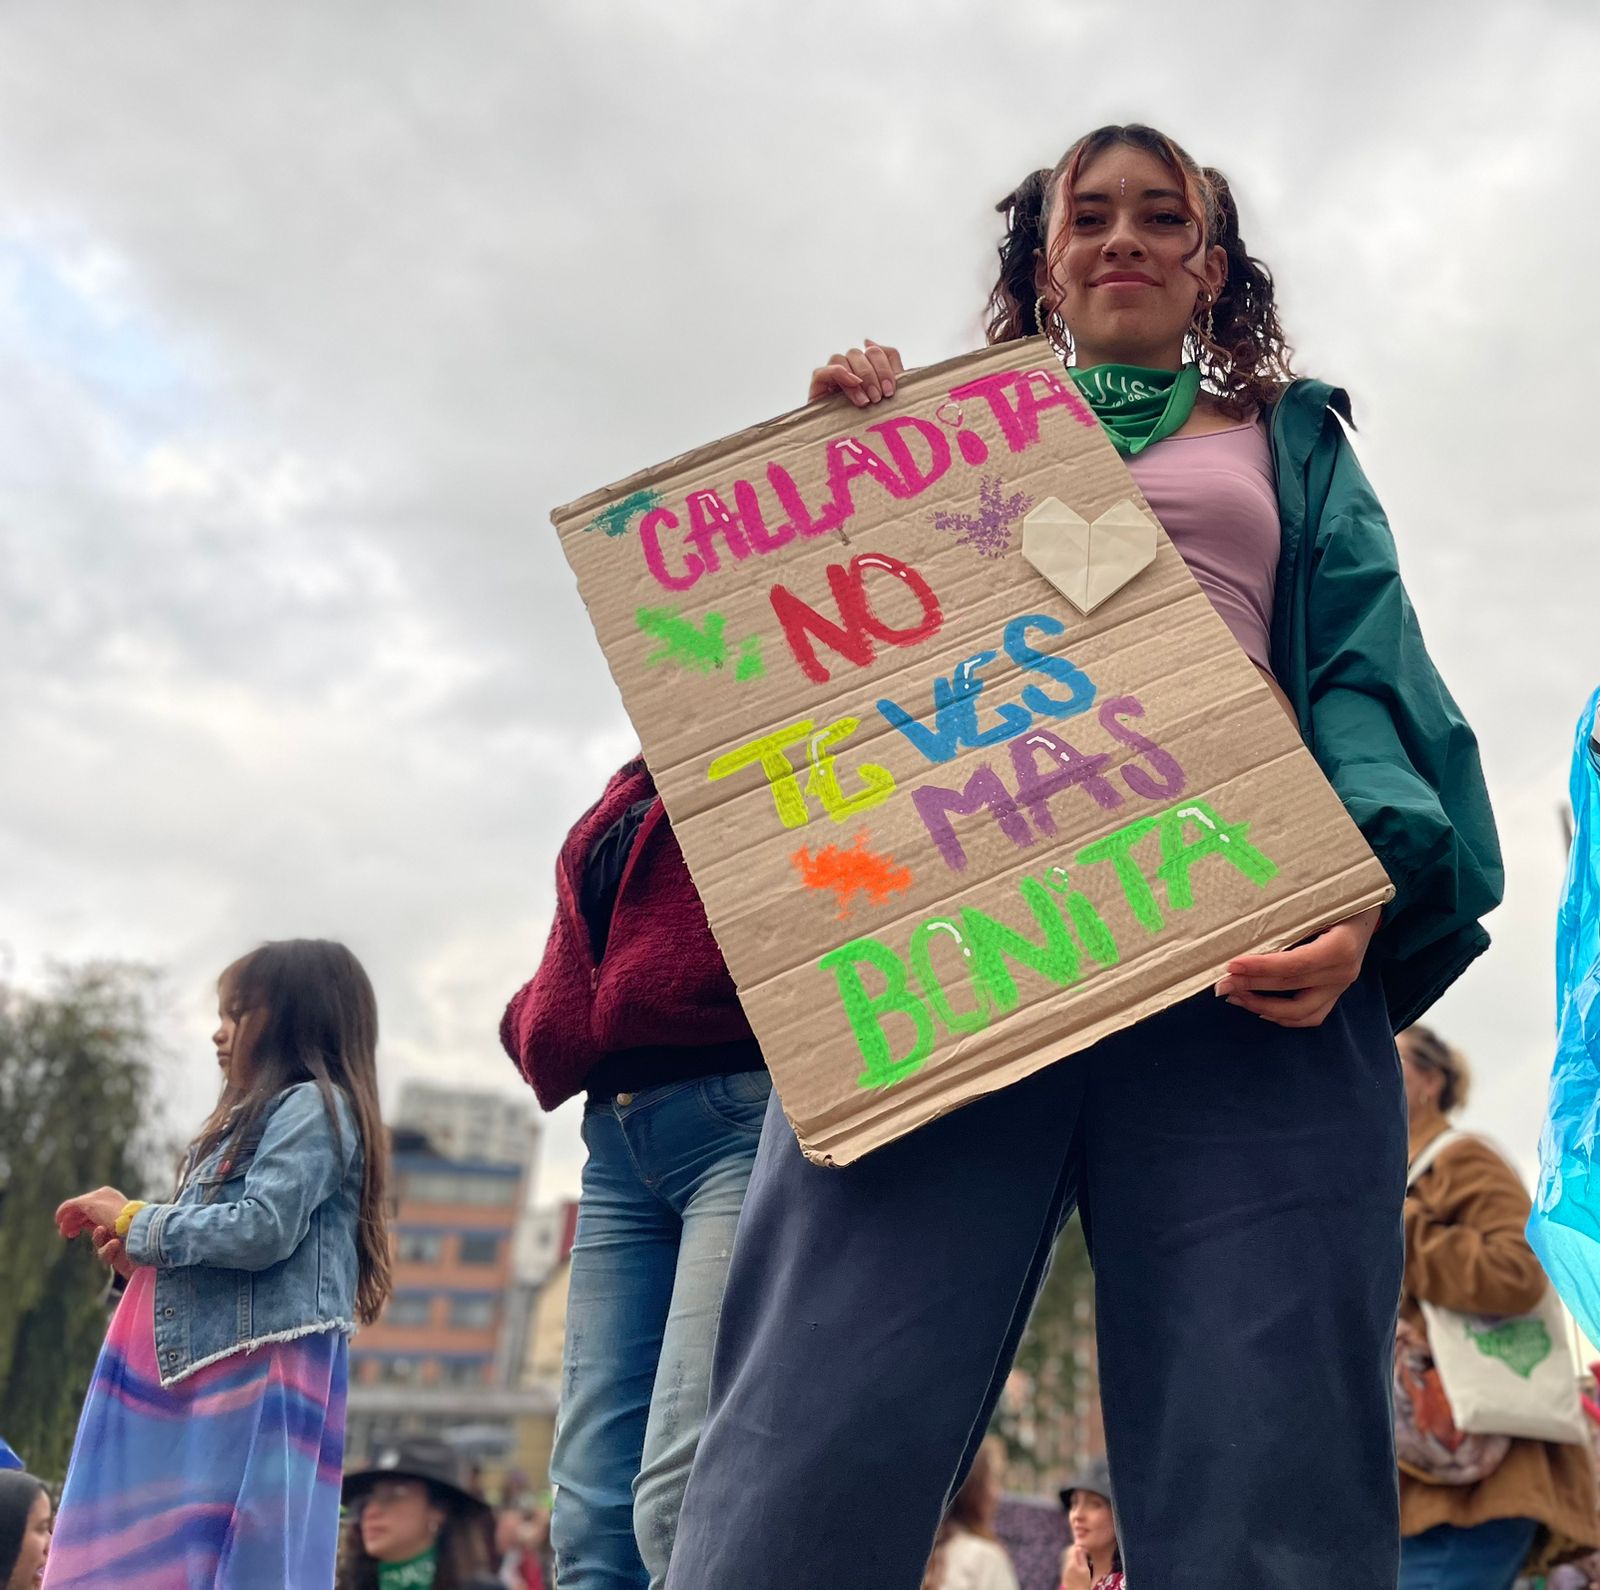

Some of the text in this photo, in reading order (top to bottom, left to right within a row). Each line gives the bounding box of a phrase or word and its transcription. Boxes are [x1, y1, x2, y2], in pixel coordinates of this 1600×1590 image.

[769, 553, 943, 682] NO
[708, 614, 1097, 828] TE VES
[912, 696, 1187, 871] MAS
